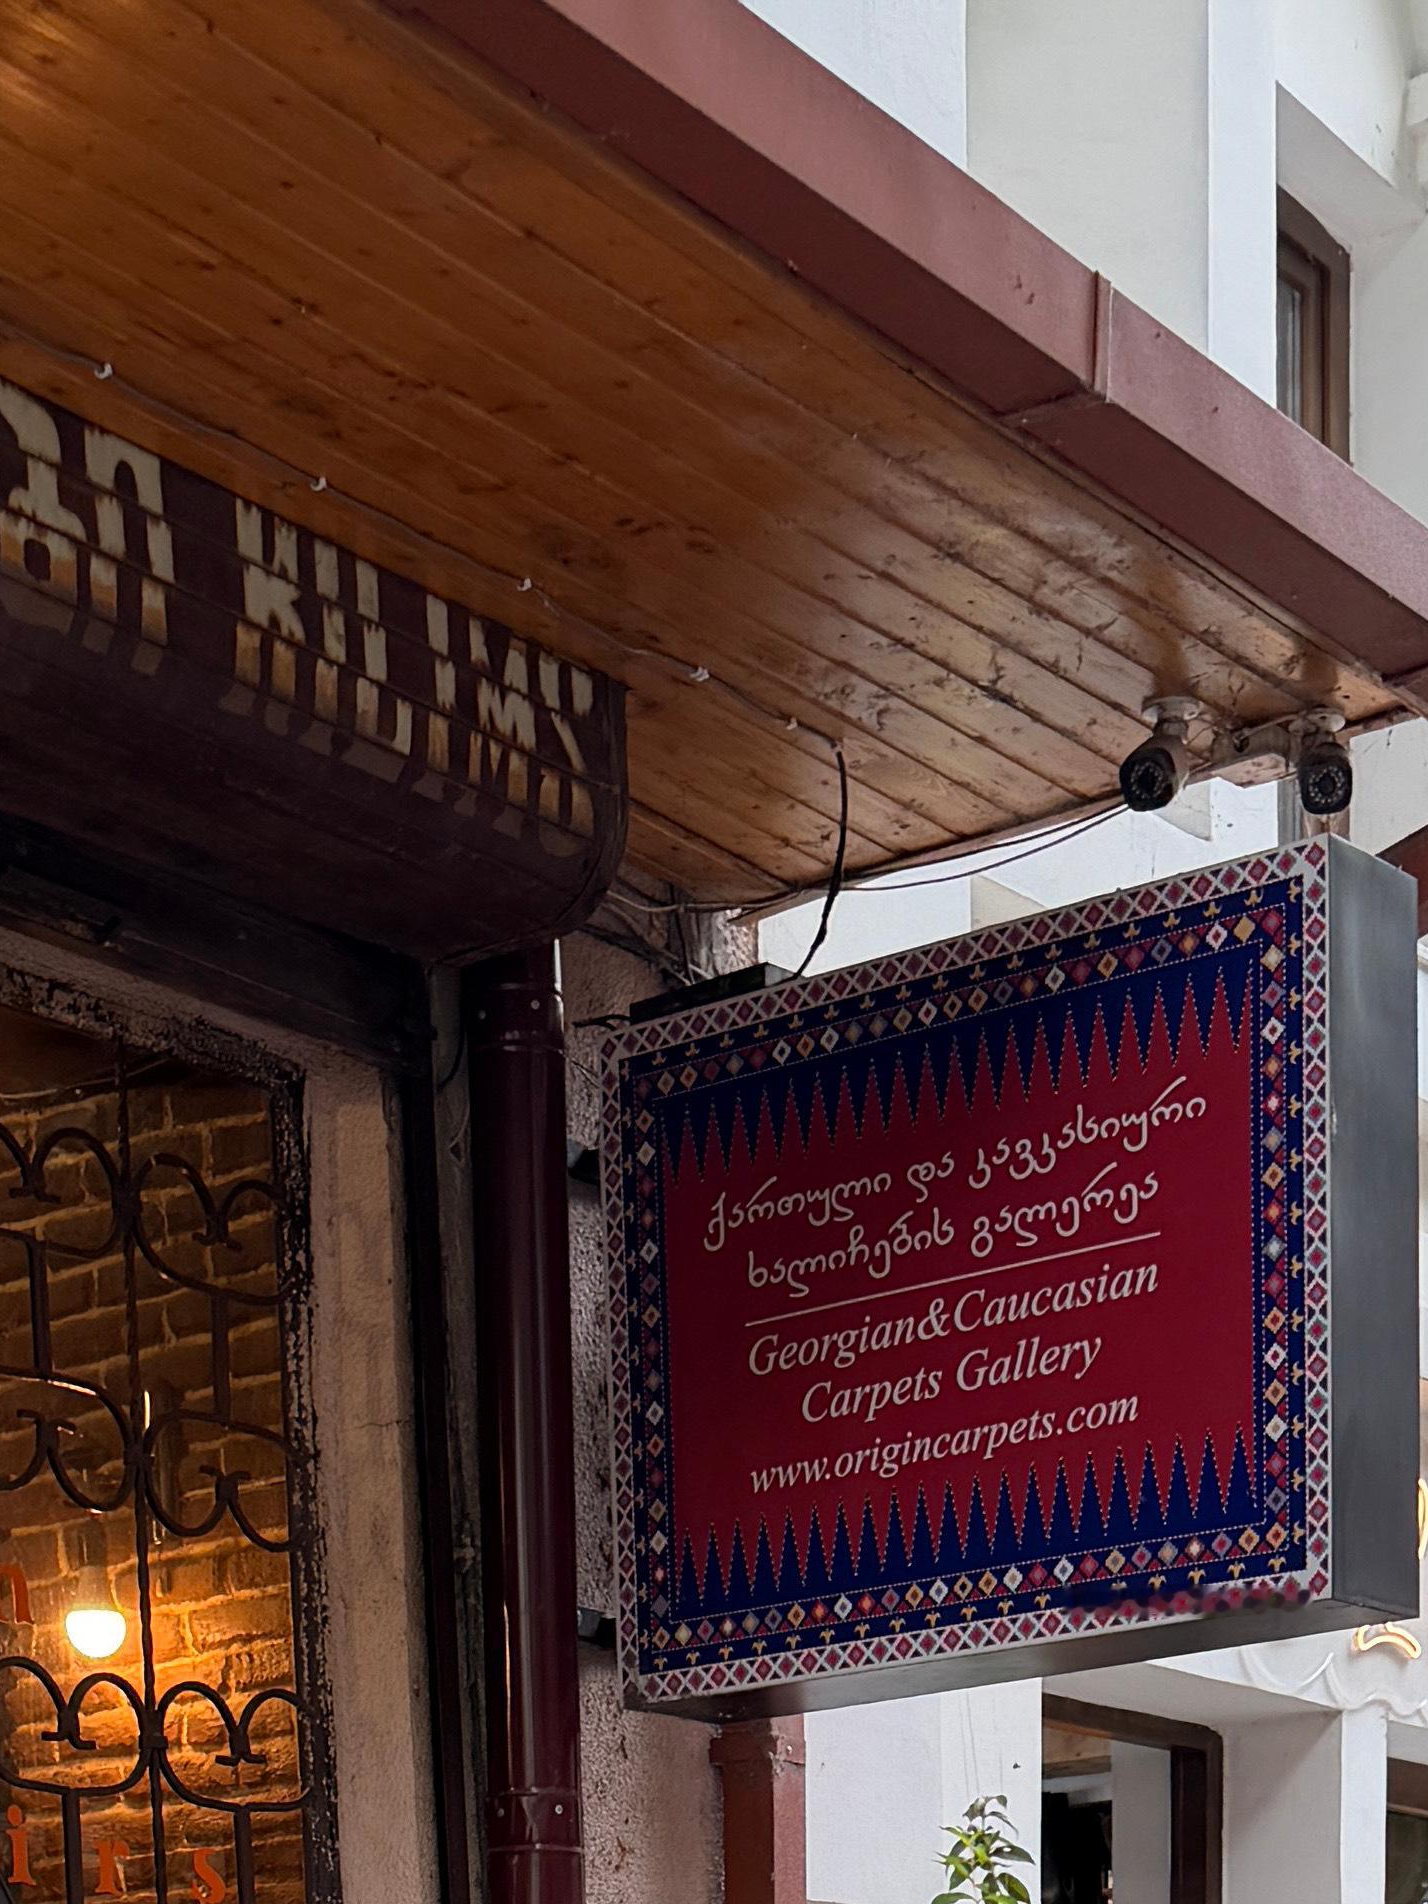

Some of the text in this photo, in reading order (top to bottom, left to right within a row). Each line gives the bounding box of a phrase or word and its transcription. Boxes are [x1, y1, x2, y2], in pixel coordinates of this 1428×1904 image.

[219, 497, 596, 858] KILIMS
[703, 1075, 1207, 1252] ქართული და კავკასიური
[747, 1161, 1160, 1298] ხალიჩების გალერეა
[749, 1263, 1159, 1376] Georgian&Caucasian
[802, 1336, 1102, 1424] Carpets Gallery
[750, 1395, 1139, 1495] www.origincarpets.com
